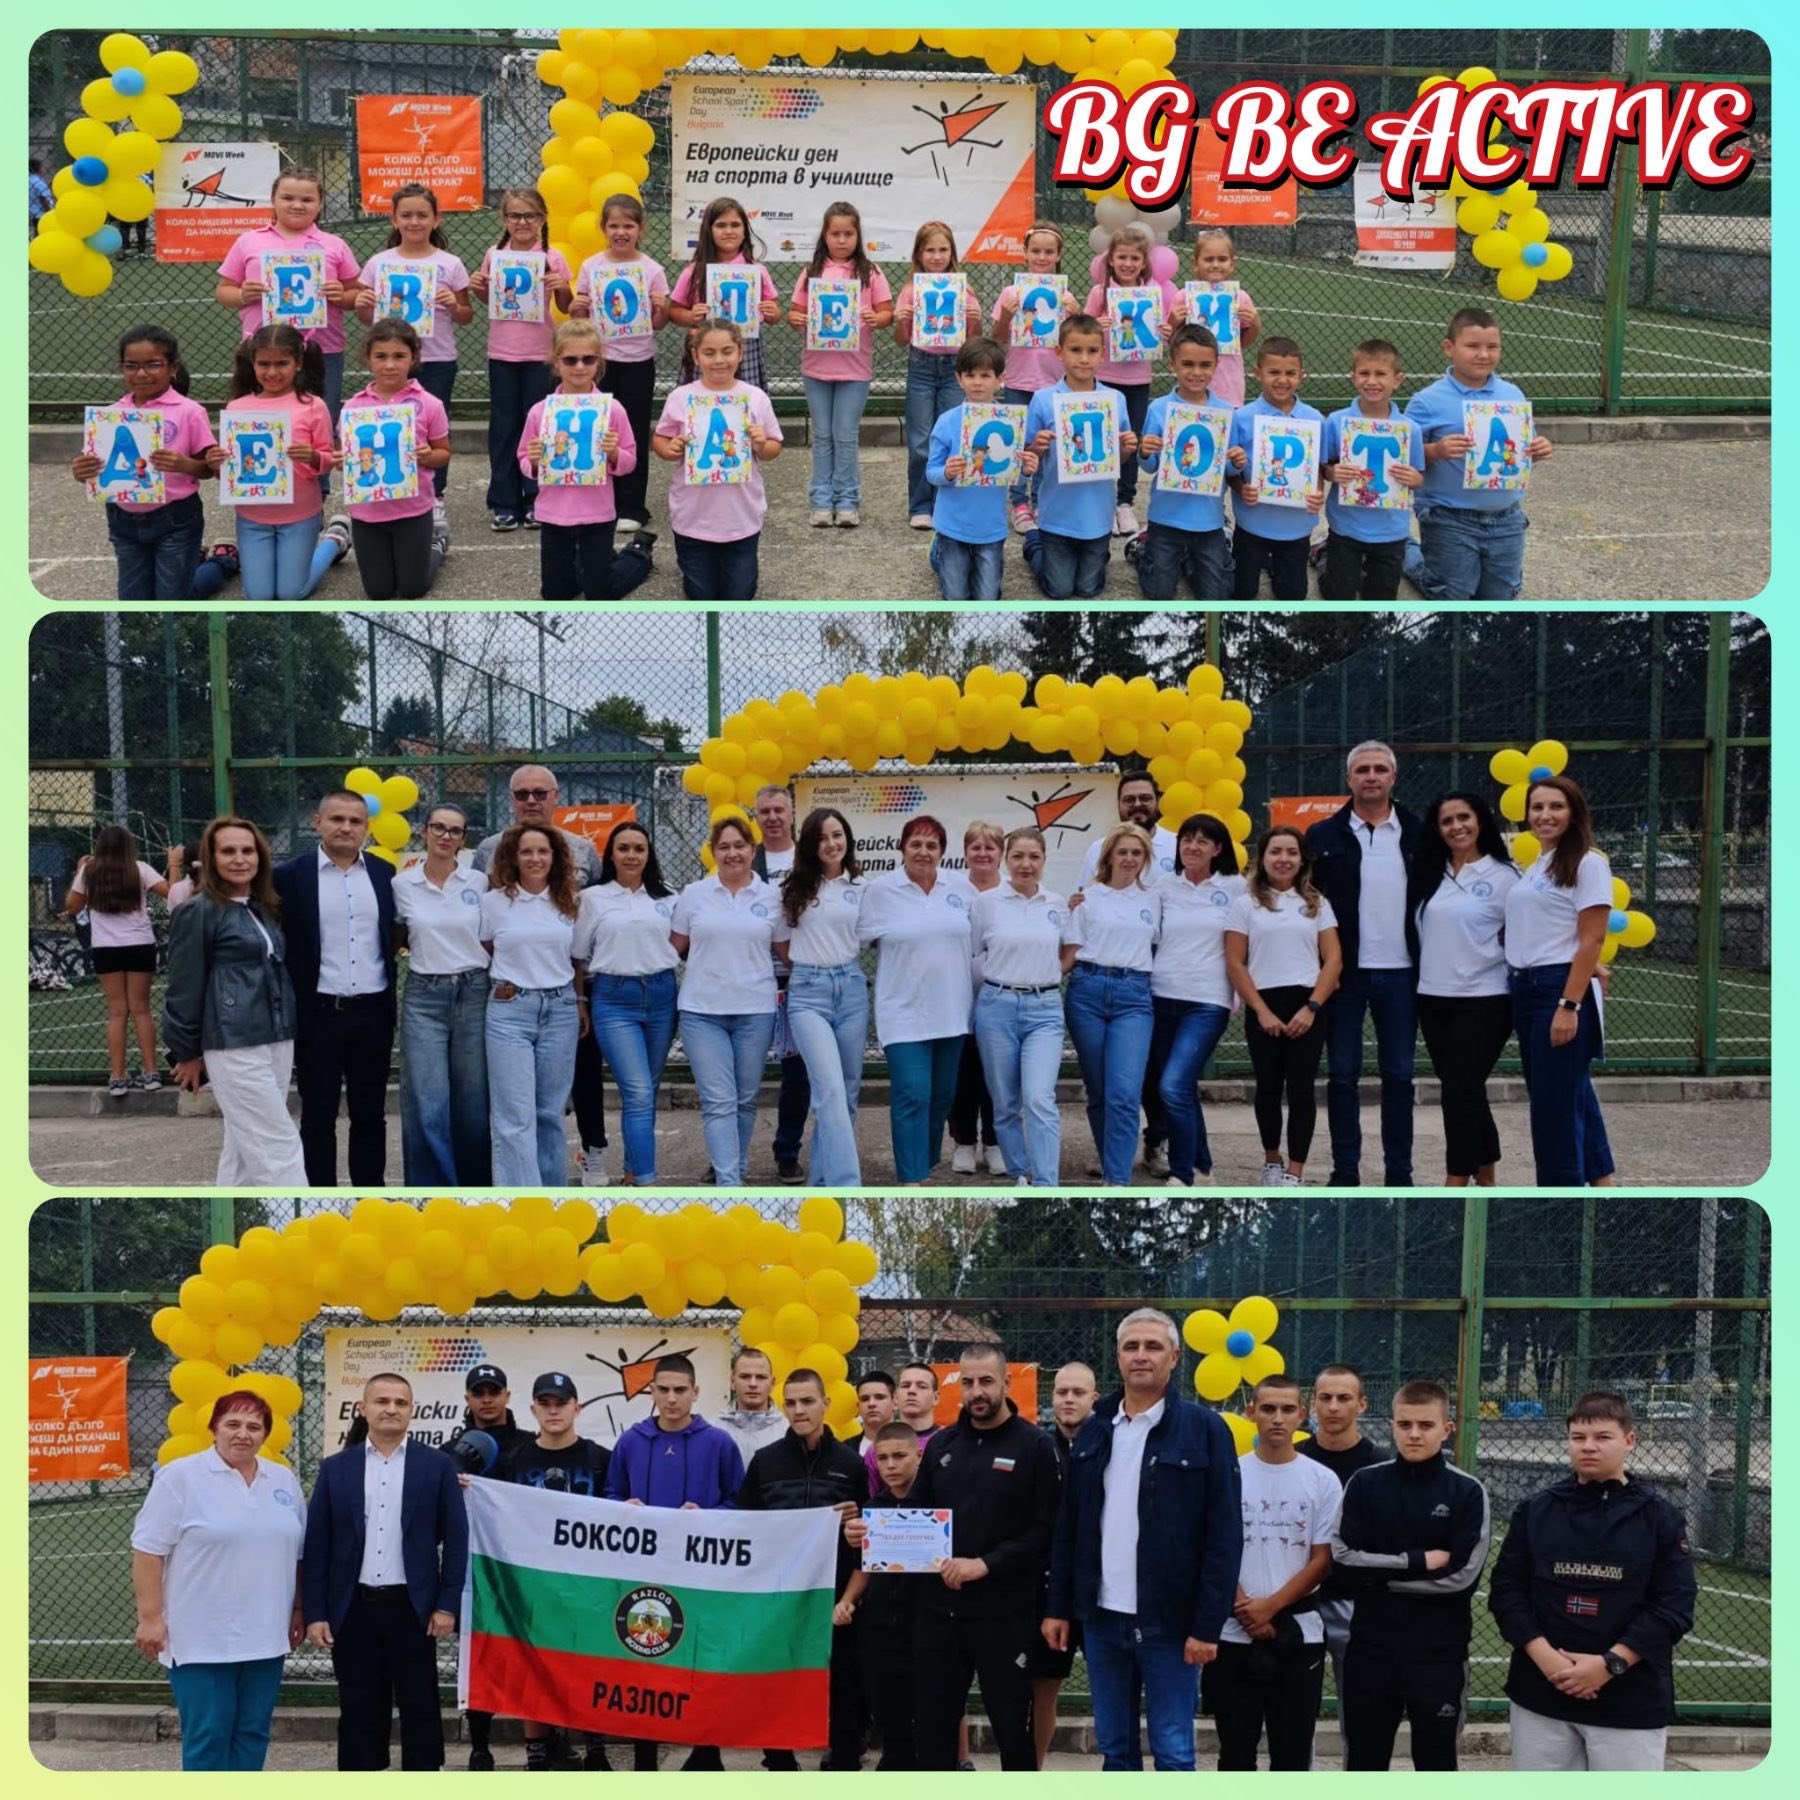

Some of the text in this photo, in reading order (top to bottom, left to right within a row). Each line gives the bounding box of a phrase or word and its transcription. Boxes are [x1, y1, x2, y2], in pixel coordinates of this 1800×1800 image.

[693, 86, 736, 96] European
[692, 97, 748, 107] School Sport
[690, 107, 707, 117] Day
[384, 155, 460, 165] КОЛКО ДЪЛГО
[686, 143, 838, 165] Европейски ден
[368, 166, 476, 177] МОЖЕШ ДА СКАЧАШ
[686, 167, 893, 188] на спорта в училище
[383, 179, 397, 188] НА
[347, 1339, 391, 1351] European
[345, 1350, 405, 1360] School Sport
[343, 1362, 360, 1373] Day
[341, 1376, 369, 1387] Bulga
[68, 1420, 104, 1432] ДЪЛГО
[57, 1433, 73, 1444] ДА
[75, 1432, 120, 1442] СКАЧАШ
[43, 1445, 73, 1456] ЕДИН
[75, 1444, 106, 1454] КРАК?
[554, 1519, 752, 1566] БОКСОВ КЛУБ
[632, 1590, 672, 1605] RAZLOG
[652, 1641, 670, 1654] CLUB
[592, 1682, 690, 1720] РАЗЛОГ
